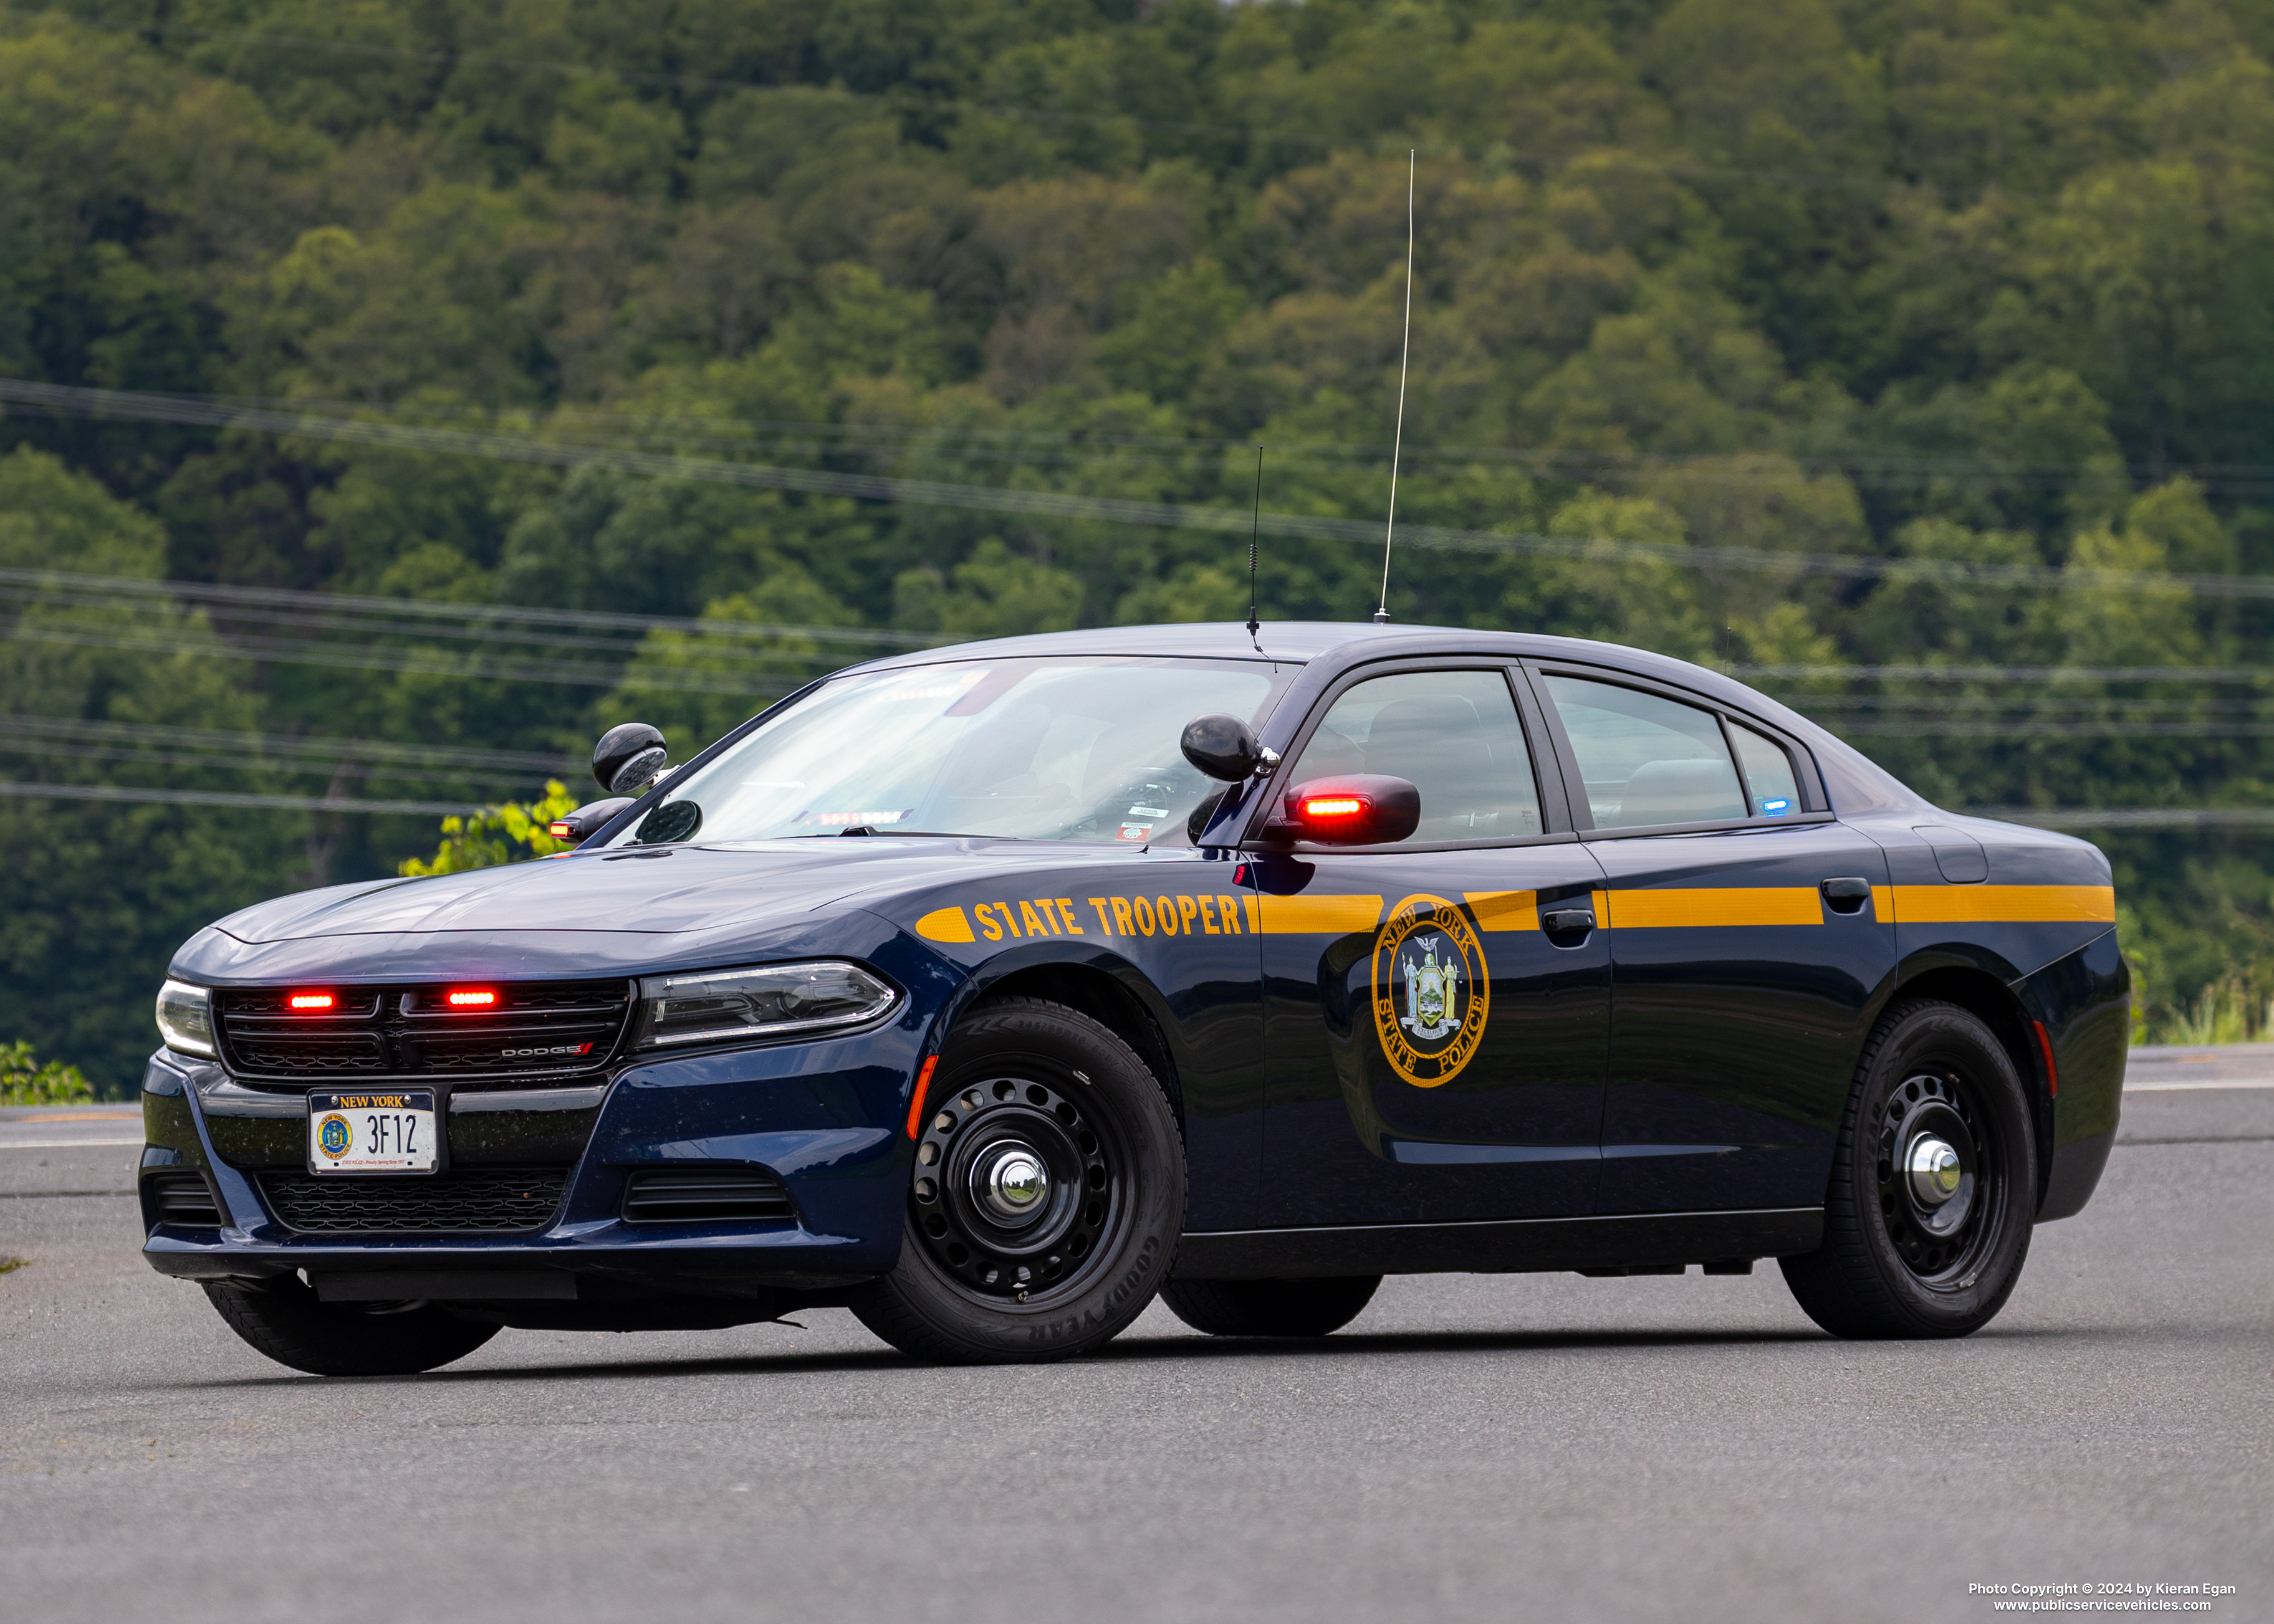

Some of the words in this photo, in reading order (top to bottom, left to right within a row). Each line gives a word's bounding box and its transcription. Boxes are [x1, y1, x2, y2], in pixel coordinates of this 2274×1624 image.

[974, 898, 1084, 940] STATE
[1088, 895, 1242, 937] TROOPER
[1383, 905, 1416, 955] NEW
[1431, 903, 1474, 956] YORK
[1379, 998, 1417, 1073] STATE
[1437, 995, 1484, 1075] POLICE
[502, 1045, 582, 1057] DODGE
[340, 1096, 370, 1108] NEW
[371, 1096, 403, 1107] YORK
[322, 1115, 332, 1126] NEW
[335, 1115, 347, 1125] YORK
[367, 1114, 416, 1154] 3F12
[320, 1144, 333, 1158] STATE
[335, 1143, 351, 1158] POLICE
